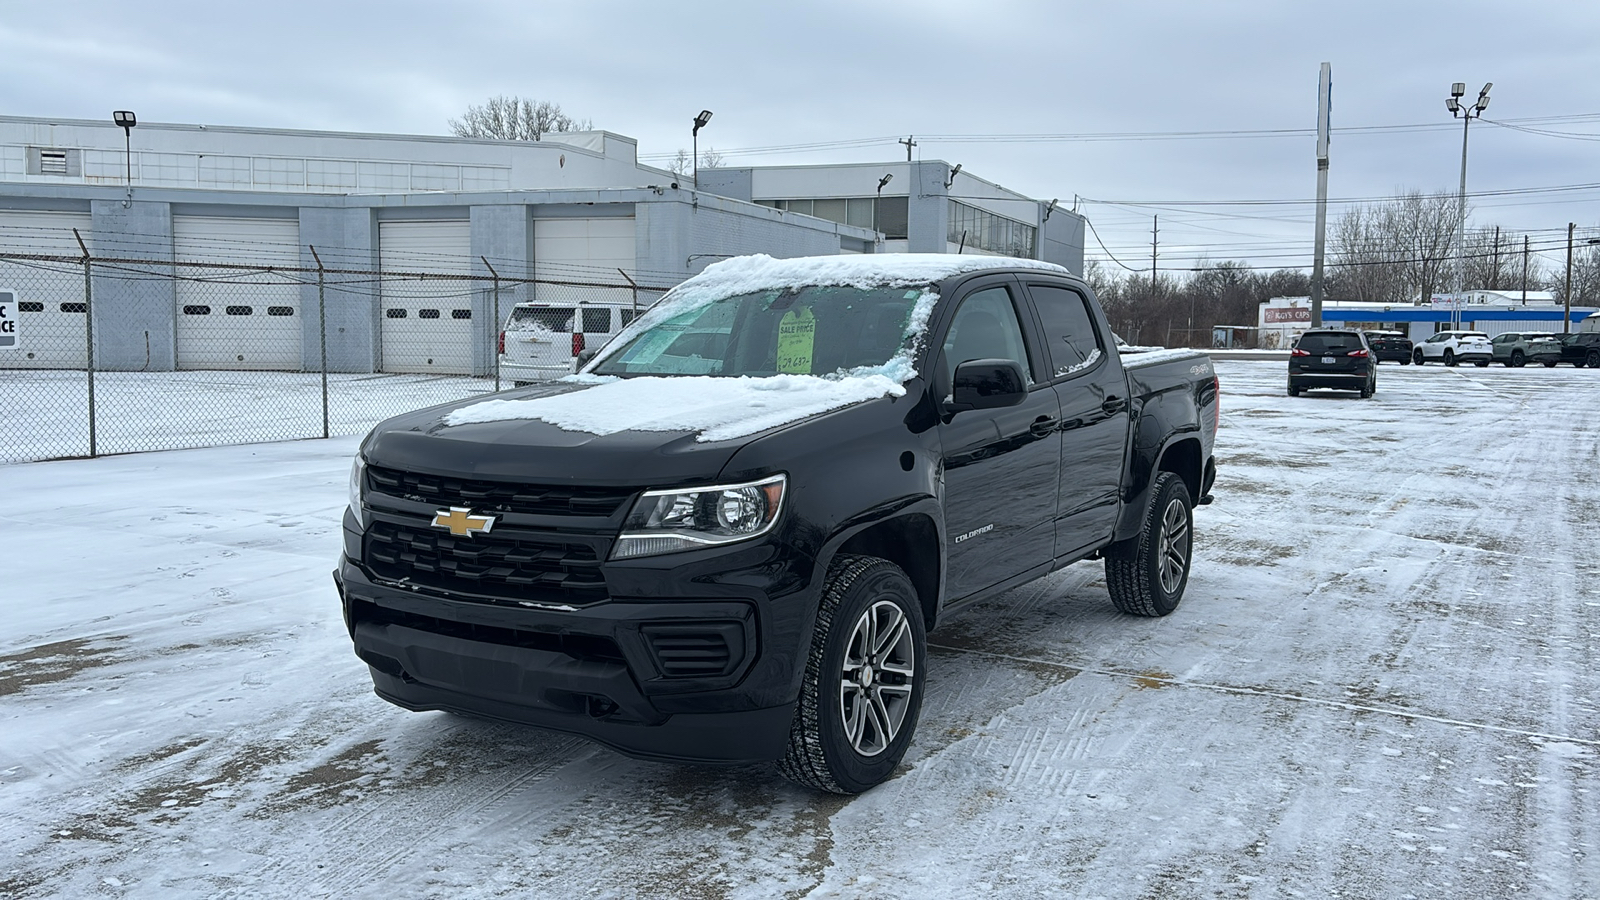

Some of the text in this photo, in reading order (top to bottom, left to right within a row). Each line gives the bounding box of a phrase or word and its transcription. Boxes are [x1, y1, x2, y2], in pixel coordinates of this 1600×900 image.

[1294, 311, 1310, 319] CAPS
[0, 320, 15, 333] CE
[780, 324, 814, 334] SALE PRICE
[955, 523, 994, 543] COLORADO
